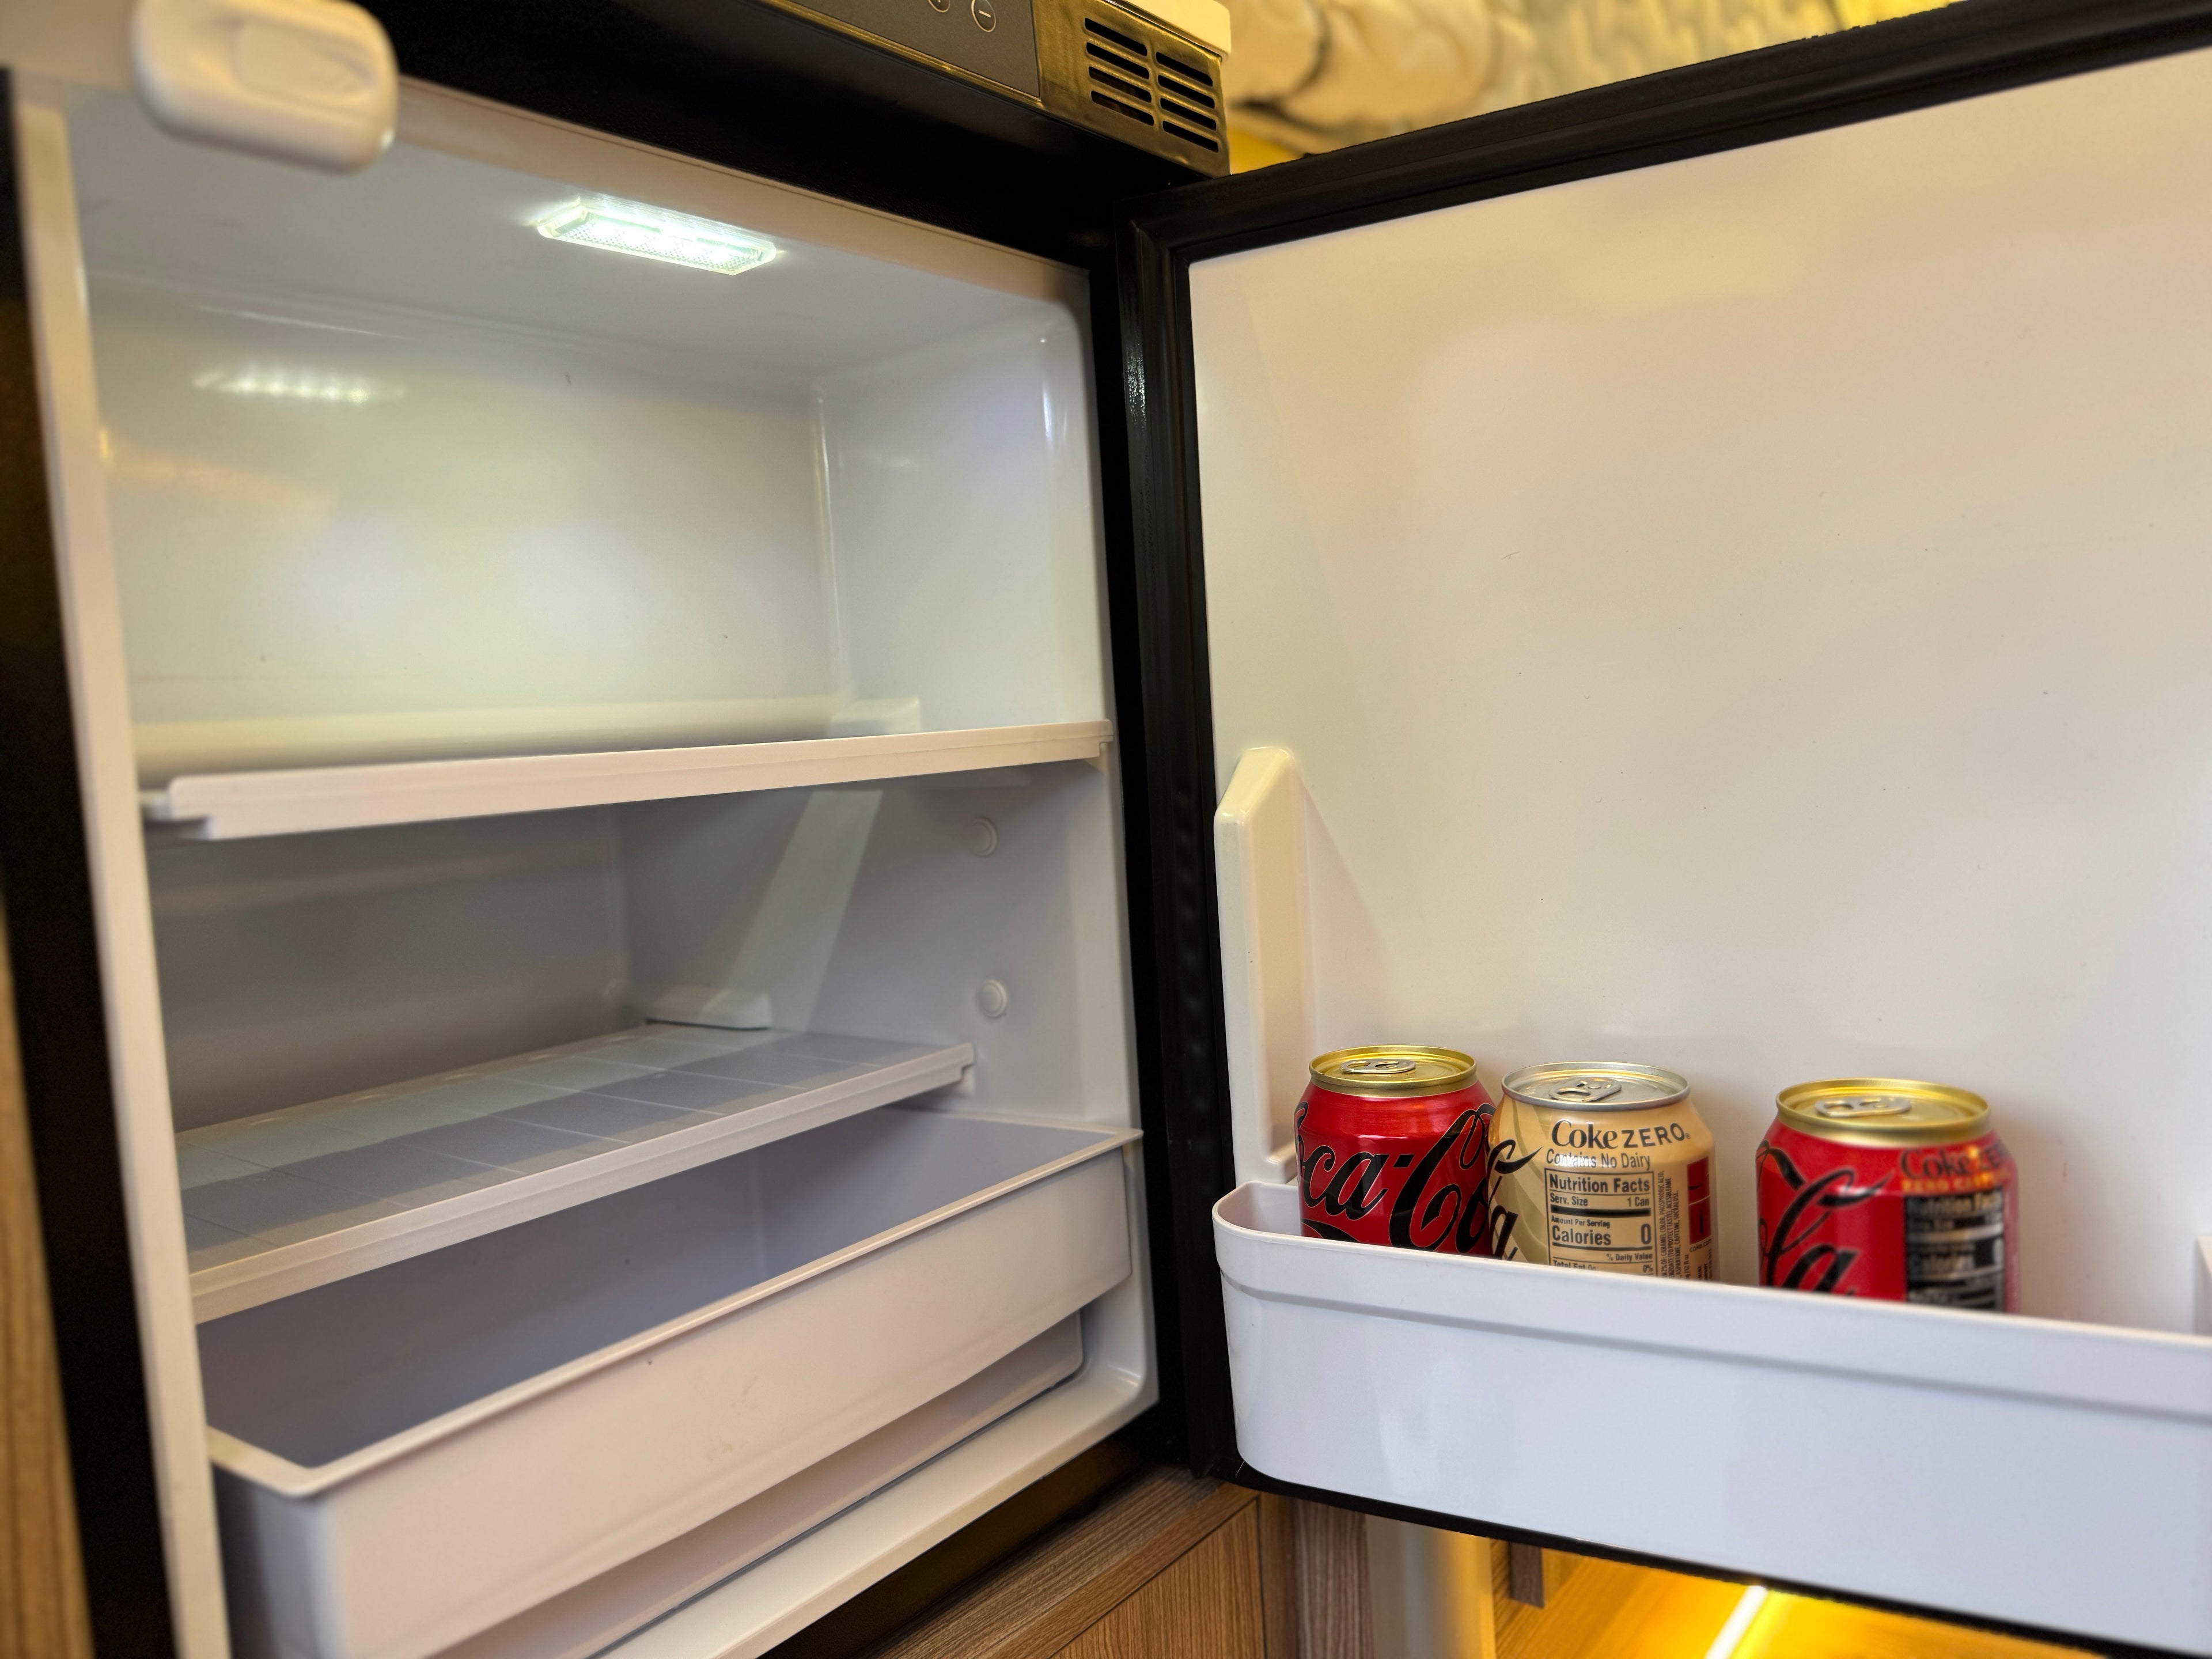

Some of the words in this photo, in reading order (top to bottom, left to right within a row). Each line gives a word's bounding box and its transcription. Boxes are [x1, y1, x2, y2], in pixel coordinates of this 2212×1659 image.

[1552, 1119, 1618, 1149] Coke
[1546, 1148, 1596, 1168] Contains
[1601, 1153, 1617, 1168] No
[1621, 1153, 1650, 1171] Dairy
[1901, 1147, 1972, 1179] Coke
[1549, 1173, 1608, 1192] Nutrition
[1613, 1178, 1650, 1192] Facts
[1550, 1192, 1570, 1205] Serv.
[1571, 1196, 1588, 1206] Size
[1627, 1197, 1631, 1207] 1
[1634, 1196, 1649, 1206] Can
[1551, 1215, 1573, 1225] Amount
[1586, 1219, 1611, 1229] Serving
[1552, 1225, 1611, 1245] Calories
[1641, 1224, 1652, 1244] 0
[1553, 1260, 1571, 1268] Total
[1643, 1264, 1653, 1272] 0%
[1616, 1253, 1633, 1262] Daily
